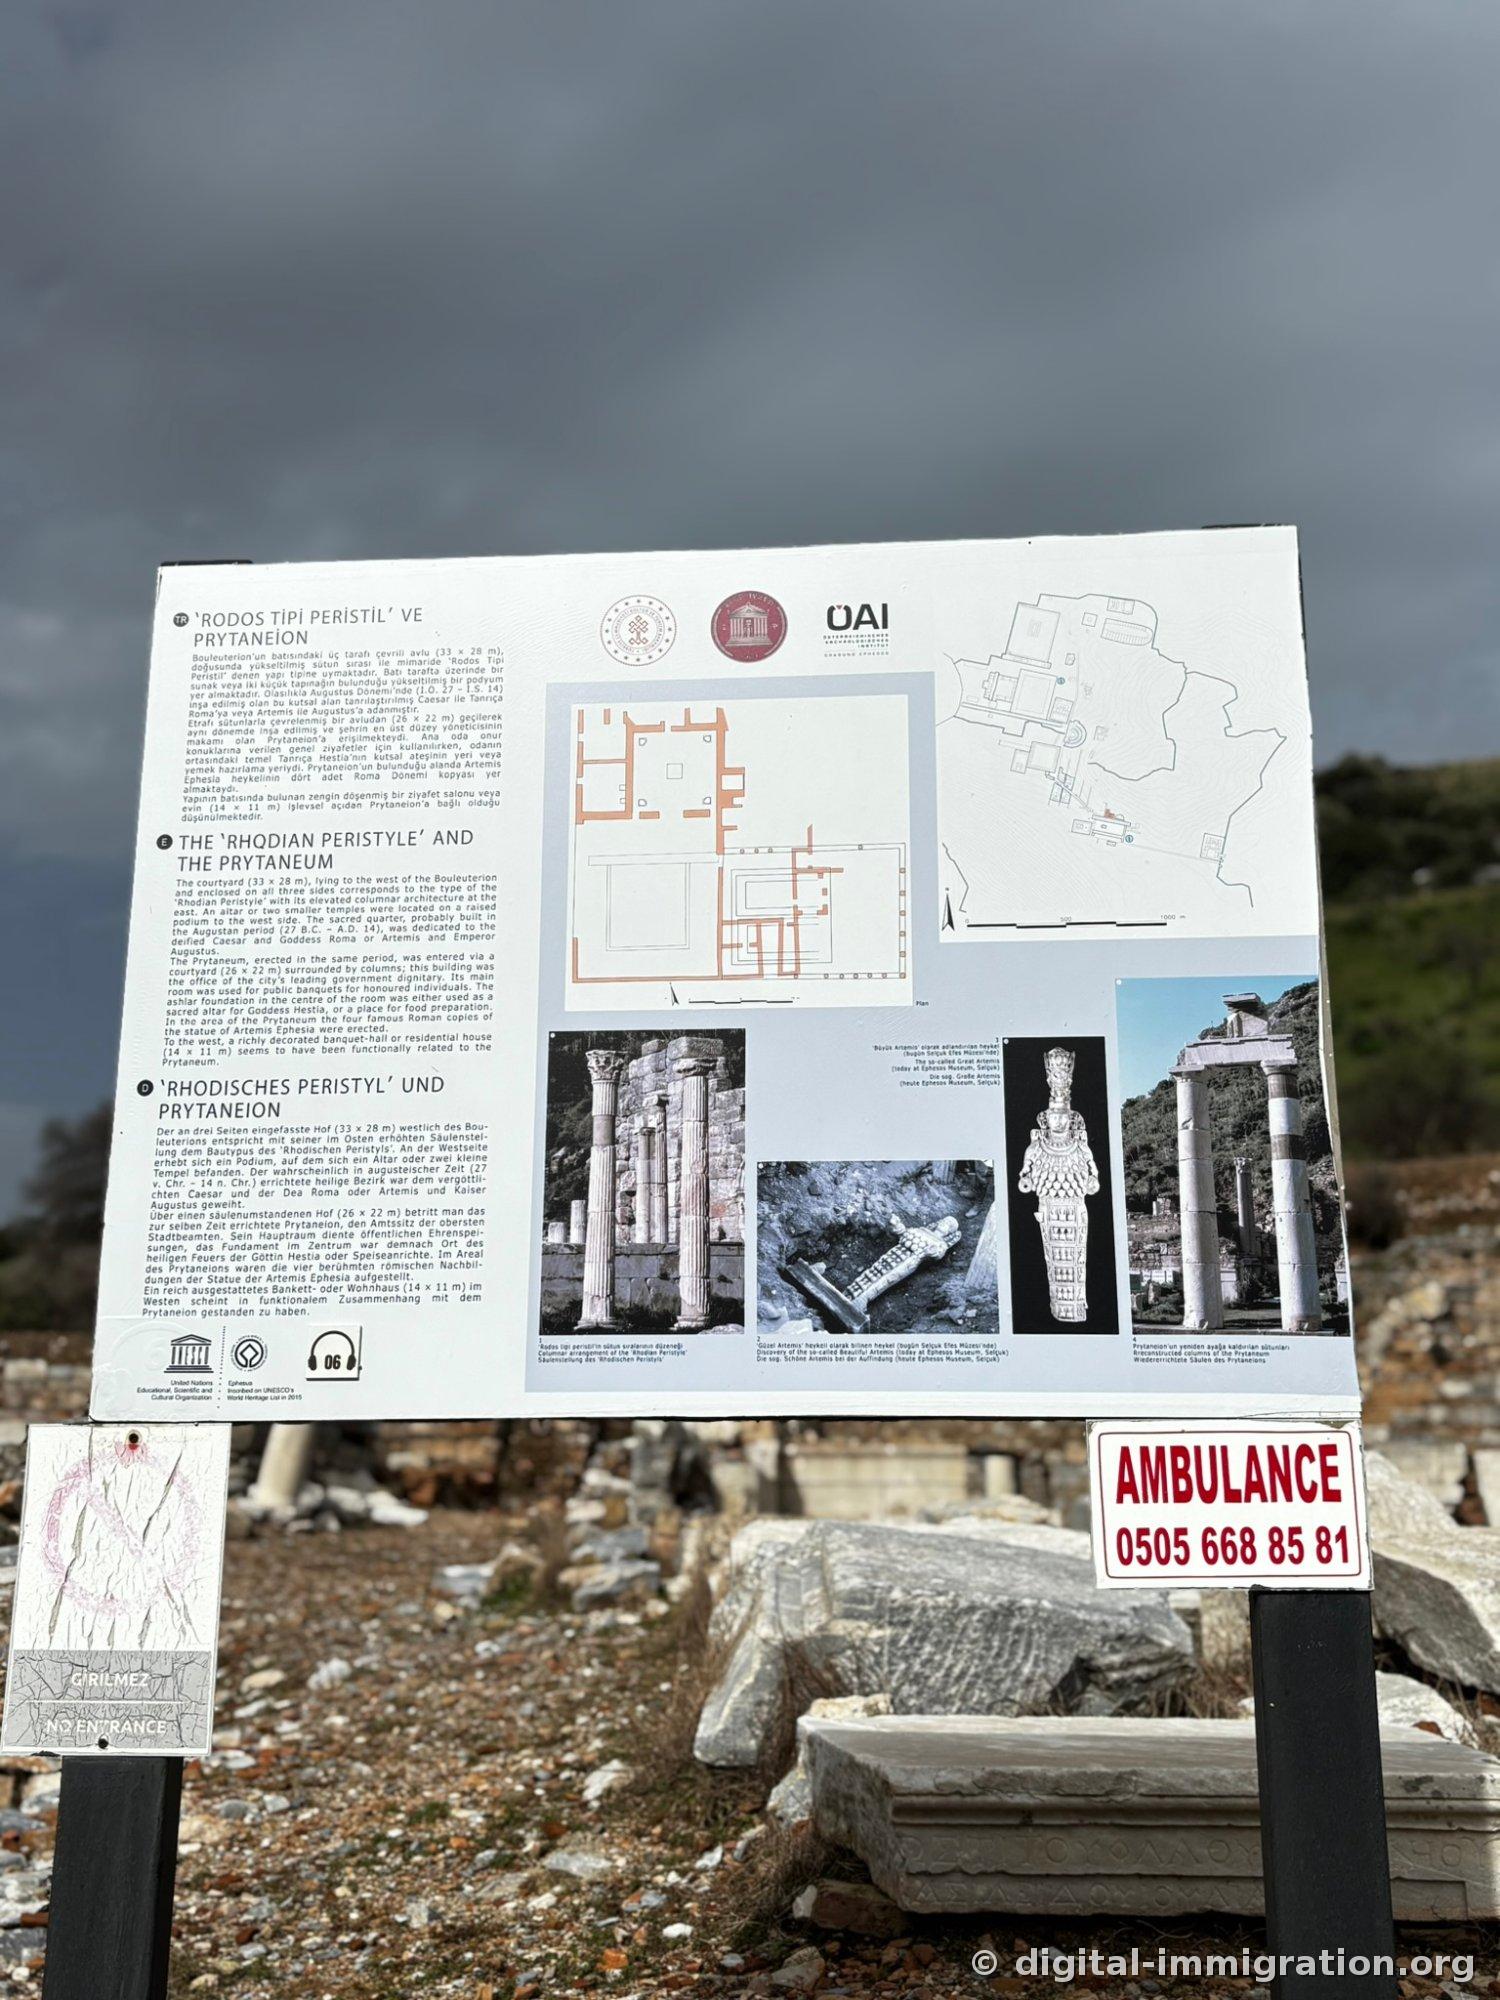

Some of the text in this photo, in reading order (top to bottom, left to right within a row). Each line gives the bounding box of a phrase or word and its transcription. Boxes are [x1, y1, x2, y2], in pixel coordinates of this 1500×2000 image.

[175, 616, 188, 624] TR
[196, 606, 423, 627] 'RODOS TİPİ PERİSTİL' VE
[194, 629, 308, 647] PRYTANEİON
[192, 651, 266, 662] Bouleuterion'un
[272, 650, 322, 660] batısındaki
[328, 650, 339, 661] üç
[345, 649, 370, 658] tarafı
[376, 648, 404, 660] çevrili
[410, 648, 430, 657] avlu
[436, 647, 452, 658] (33
[471, 647, 482, 655] 28
[488, 646, 504, 657] m),
[181, 812, 263, 824] düşünülmektedir.
[179, 835, 214, 850] THE
[322, 829, 424, 847] PERISTYLE'
[432, 830, 474, 845] AND
[178, 854, 333, 871] THE PRYTANEUM
[176, 878, 194, 886] The
[196, 877, 244, 888] courtyard
[248, 876, 265, 888] (33
[279, 876, 291, 885] 28
[294, 876, 311, 887] m),
[315, 875, 340, 886] lying
[343, 875, 353, 884] to
[356, 875, 372, 884] the
[376, 875, 399, 884] west
[401, 874, 412, 883] of
[415, 874, 431, 883] the
[434, 873, 497, 883] Bouleuterion
[163, 1037, 175, 1045] To
[178, 1036, 195, 1045] the
[198, 1036, 225, 1047] west,
[238, 1035, 267, 1046] richly
[269, 1035, 320, 1044] decorated
[323, 1034, 388, 1045] banquet-hall
[405, 1033, 459, 1042] residential
[462, 1032, 492, 1042] house
[161, 1076, 445, 1096] 'RHODISCHES PERISTYL' UND
[159, 1102, 281, 1119] PRYTANEION
[156, 1126, 175, 1135] Der
[193, 1126, 213, 1135] drei
[216, 1125, 249, 1134] Seiten
[252, 1124, 311, 1136] eingefasste
[313, 1124, 332, 1133] Hof
[334, 1124, 352, 1135] (33
[366, 1124, 379, 1132] 28
[382, 1123, 396, 1134] m)
[399, 1123, 441, 1132] westlich
[443, 1122, 462, 1132] des
[140, 1307, 198, 1319] Prytaneion
[201, 1307, 255, 1318] gestanden
[275, 1307, 310, 1316] haben.
[324, 1355, 341, 1370] 06
[1116, 1443, 1342, 1504] AMBULANCE
[1116, 1525, 1349, 1566] 0505 668 85 81
[46, 1719, 71, 1733] NO
